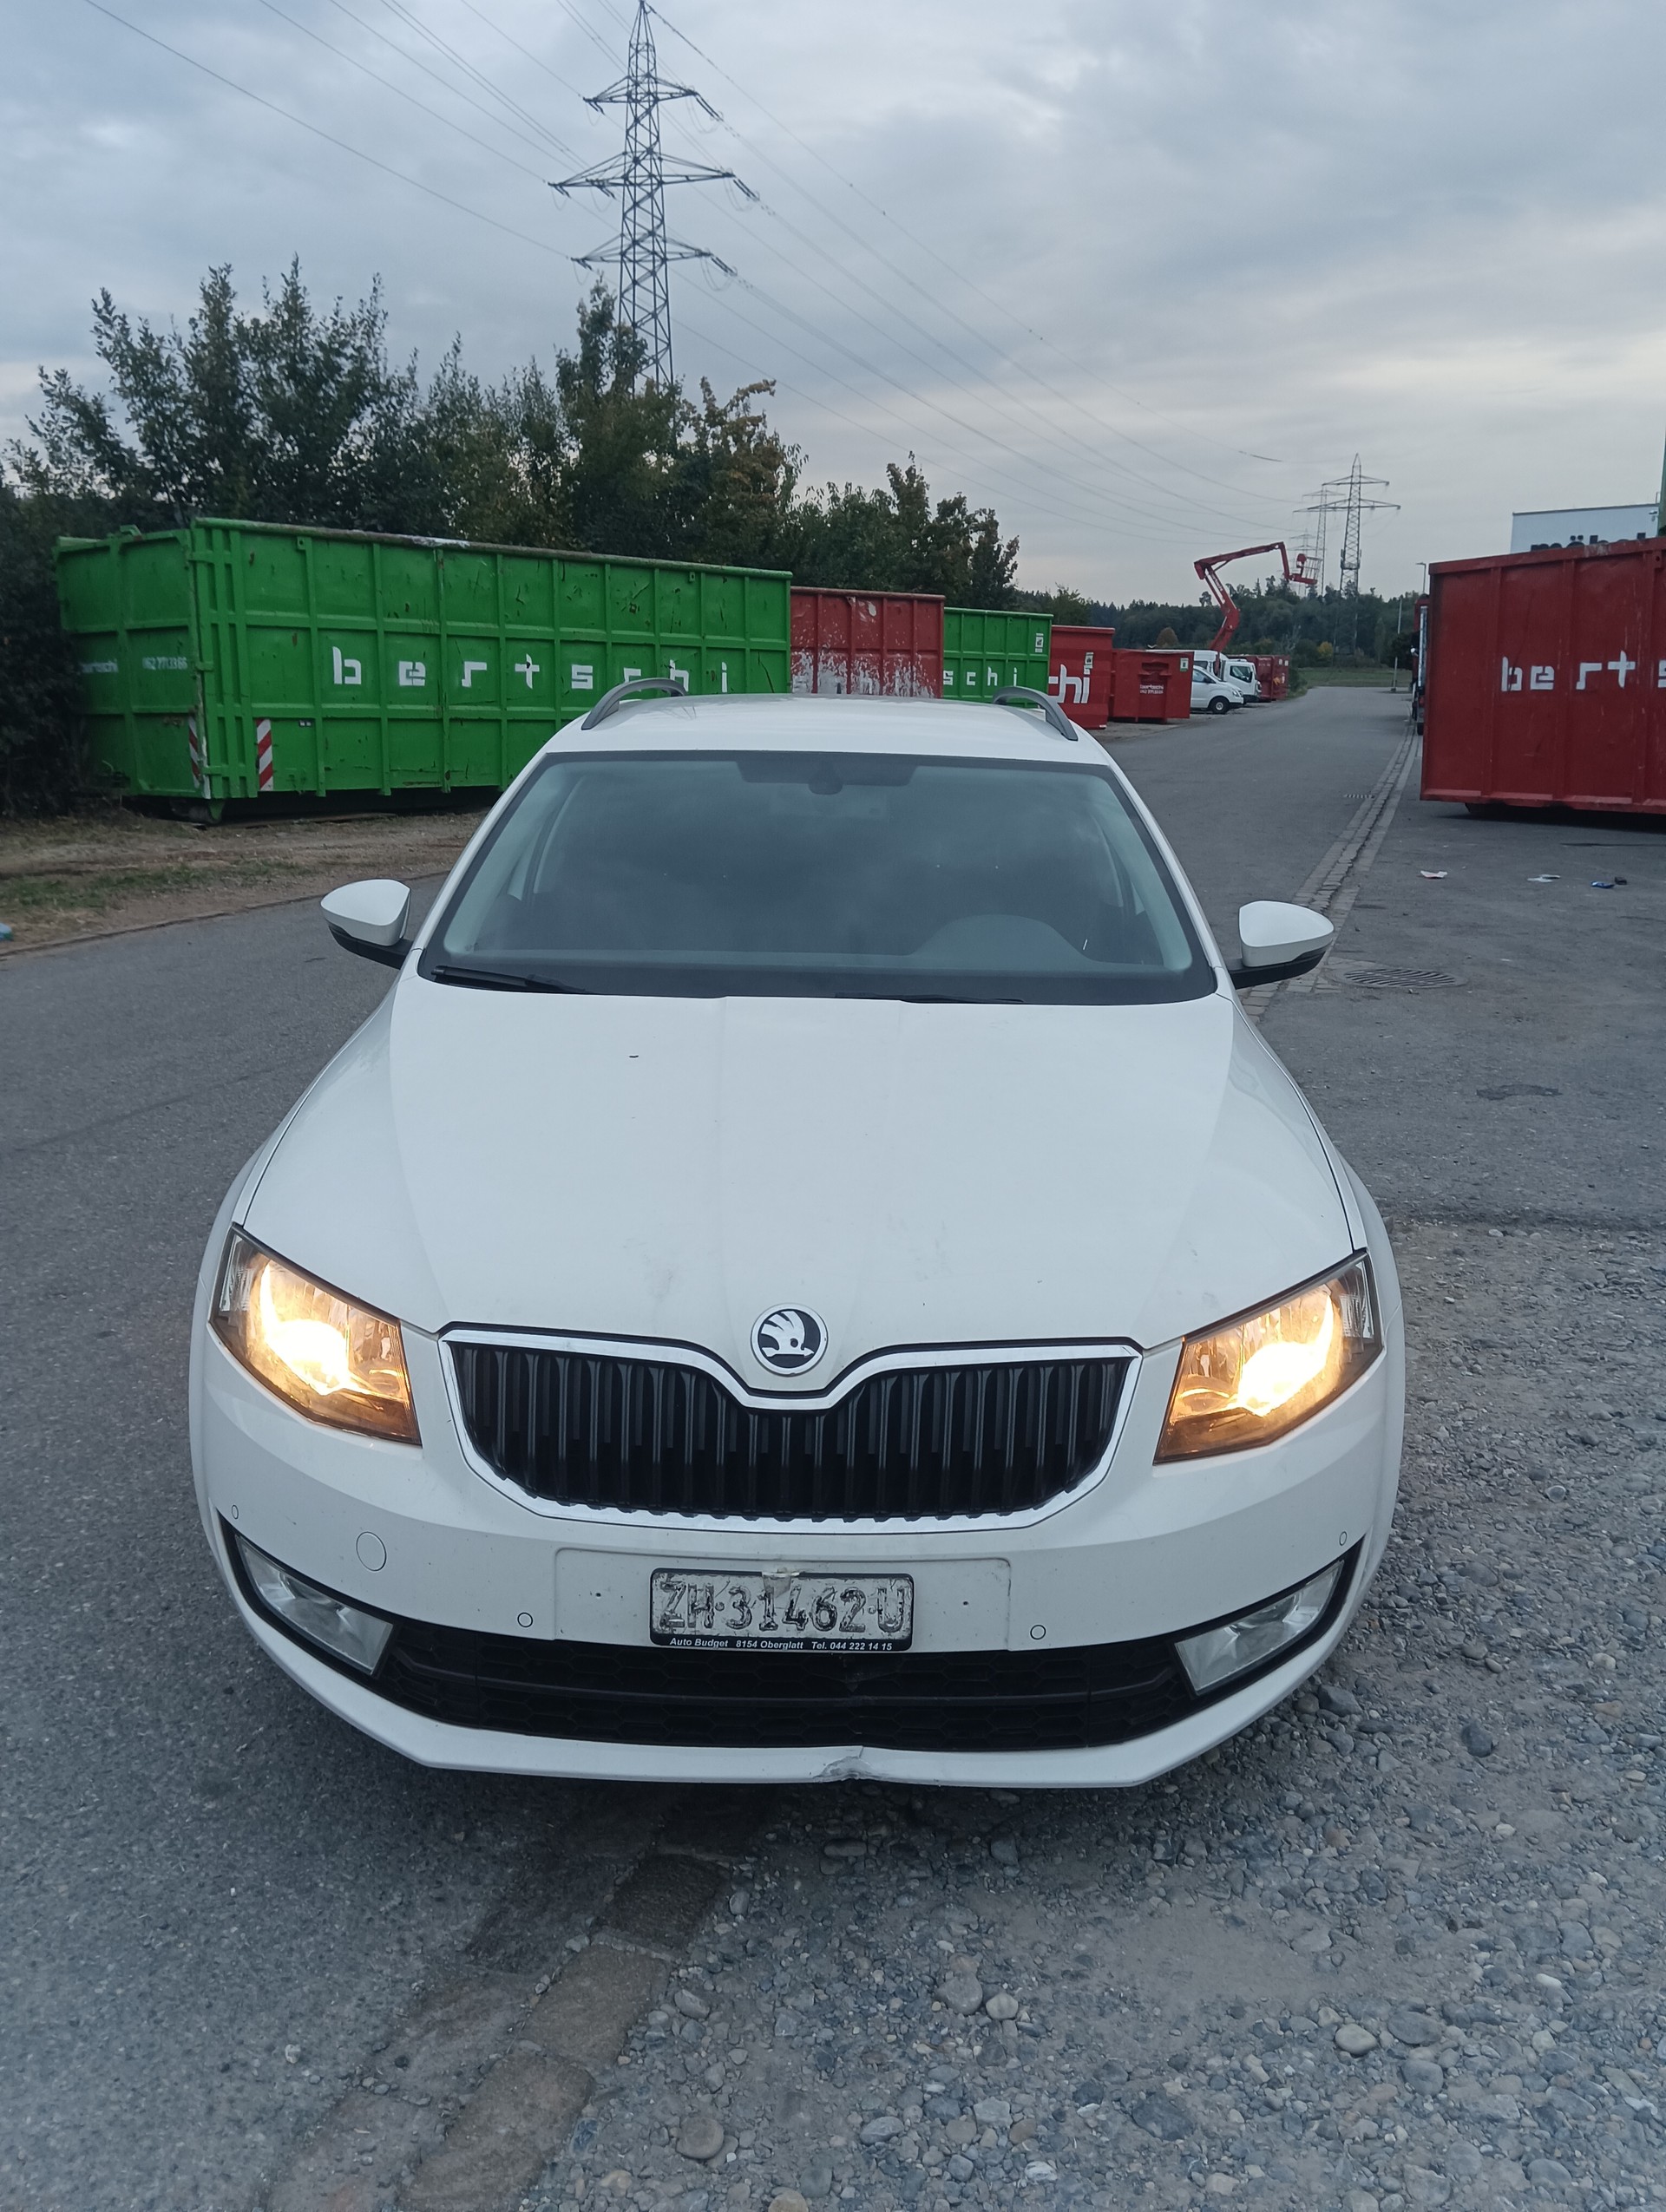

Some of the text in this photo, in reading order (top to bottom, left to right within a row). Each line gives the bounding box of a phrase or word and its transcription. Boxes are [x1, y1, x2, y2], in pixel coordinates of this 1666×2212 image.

[332, 646, 727, 692] bertschi
[669, 1637, 692, 1646] Auto
[694, 1638, 729, 1648] Budget
[735, 1639, 758, 1648] 8154
[760, 1640, 803, 1650] Oberglatt
[811, 1641, 827, 1650] Tel.
[849, 1642, 866, 1651] 222
[869, 1642, 879, 1651] 14
